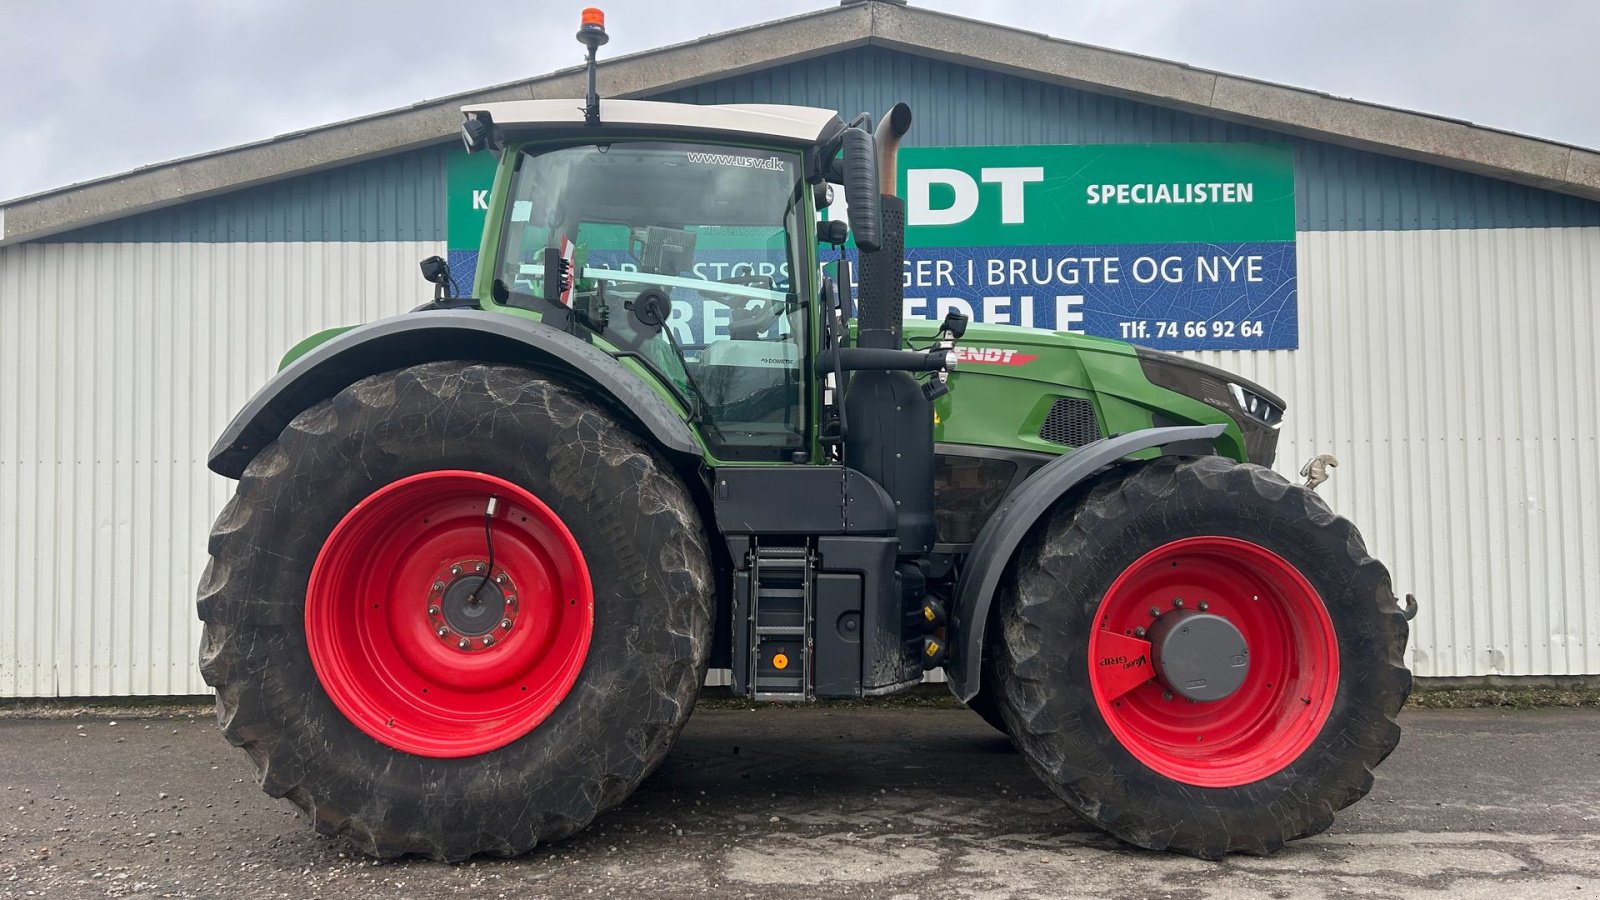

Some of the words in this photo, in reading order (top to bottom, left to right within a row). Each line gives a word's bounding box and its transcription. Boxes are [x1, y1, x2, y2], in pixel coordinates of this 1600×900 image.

[687, 152, 785, 172] www.usv.dk
[1086, 183, 1253, 204] SPECIALISTEN
[968, 259, 973, 286] I
[987, 257, 1120, 286] BRUGTE
[1132, 256, 1183, 284] OG
[1197, 255, 1263, 283] NYE
[1119, 321, 1151, 339] Tlf.
[1155, 321, 1179, 338] 74
[1183, 320, 1207, 338] 66
[1212, 320, 1235, 338] 92
[1240, 320, 1264, 338] 64
[954, 345, 1019, 364] ENDT
